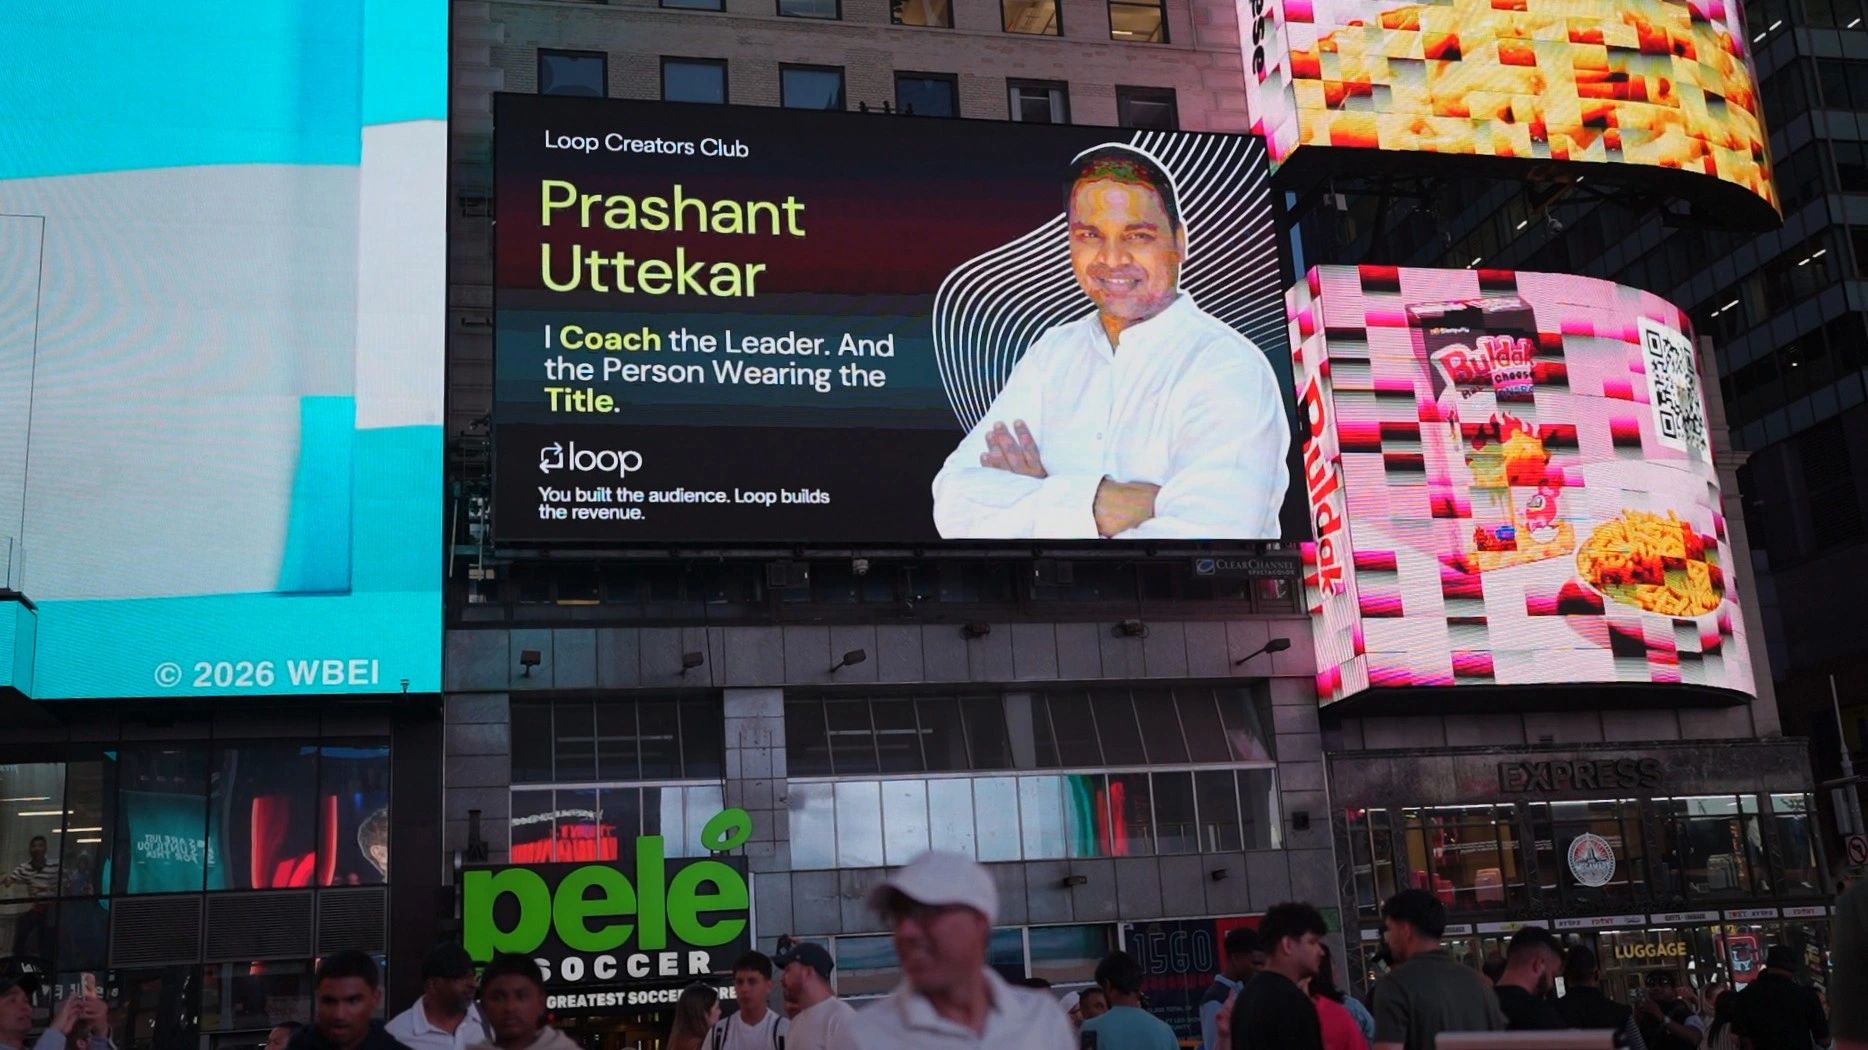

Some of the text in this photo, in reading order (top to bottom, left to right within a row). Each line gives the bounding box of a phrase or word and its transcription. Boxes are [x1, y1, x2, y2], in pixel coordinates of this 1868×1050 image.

[545, 130, 749, 158] Loop Creators Club
[542, 179, 806, 237] Prashant
[541, 243, 766, 297] Uttekar
[545, 325, 895, 358] I Coach the Leader. And
[544, 356, 886, 393] the Person Wearing the
[544, 387, 621, 413] Title.
[569, 441, 643, 478] loop
[539, 487, 831, 507] You built the audience. Loop builds
[539, 504, 646, 520] the revenue.
[193, 661, 275, 687] 2026
[287, 659, 380, 685] WBEI
[1500, 758, 1663, 793] EXPRESS
[1615, 942, 1687, 960] LUGGAGE
[546, 992, 625, 1009] GREATEST
